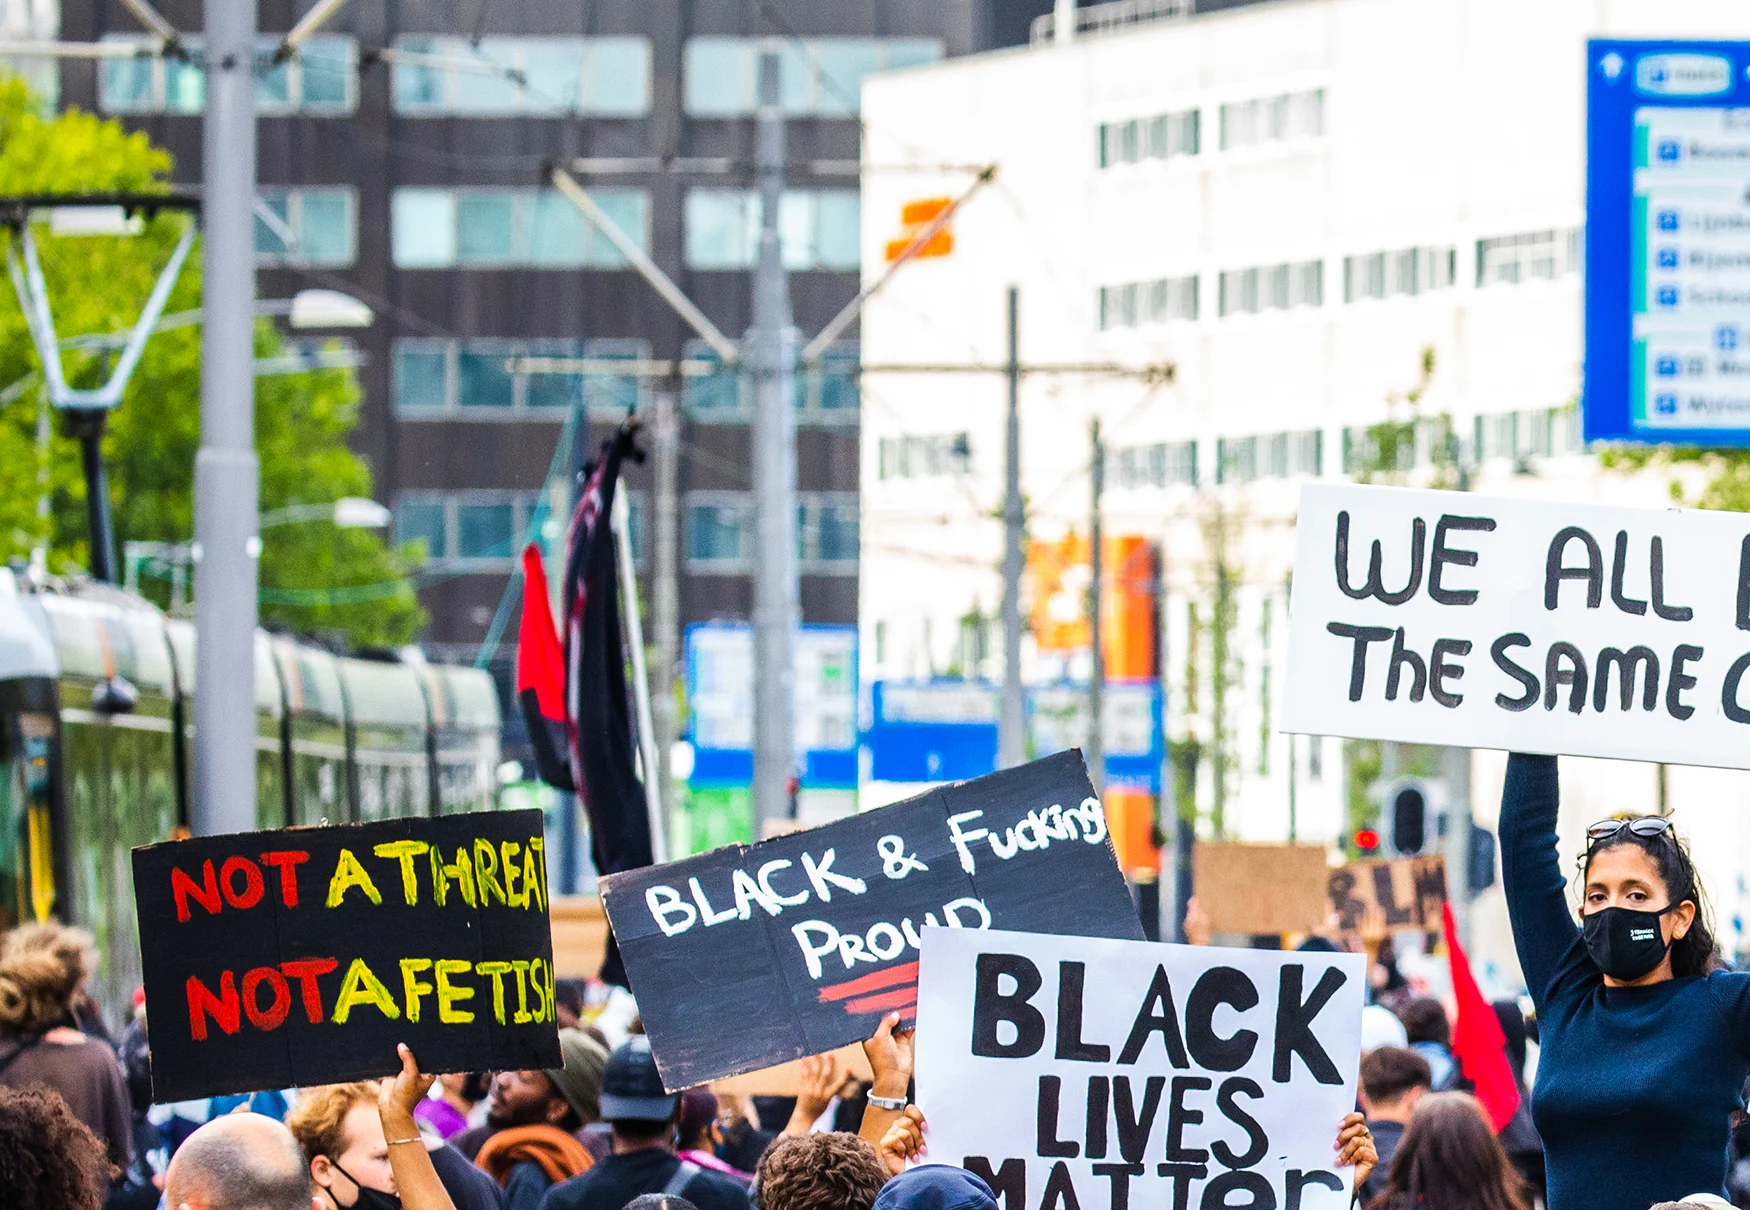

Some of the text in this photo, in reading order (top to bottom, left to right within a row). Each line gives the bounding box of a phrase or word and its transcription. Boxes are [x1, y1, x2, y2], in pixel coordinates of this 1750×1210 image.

[1335, 510, 1497, 605] WE
[1544, 526, 1693, 622] ALL
[1489, 632, 1704, 721] SAME
[171, 836, 548, 923] NOT A THREAT
[644, 847, 868, 936] BLACK
[876, 835, 929, 879] &
[186, 956, 556, 1041] NOT A FETISH
[971, 953, 1347, 1085] BLACK
[1037, 1075, 1269, 1168] LIVES
